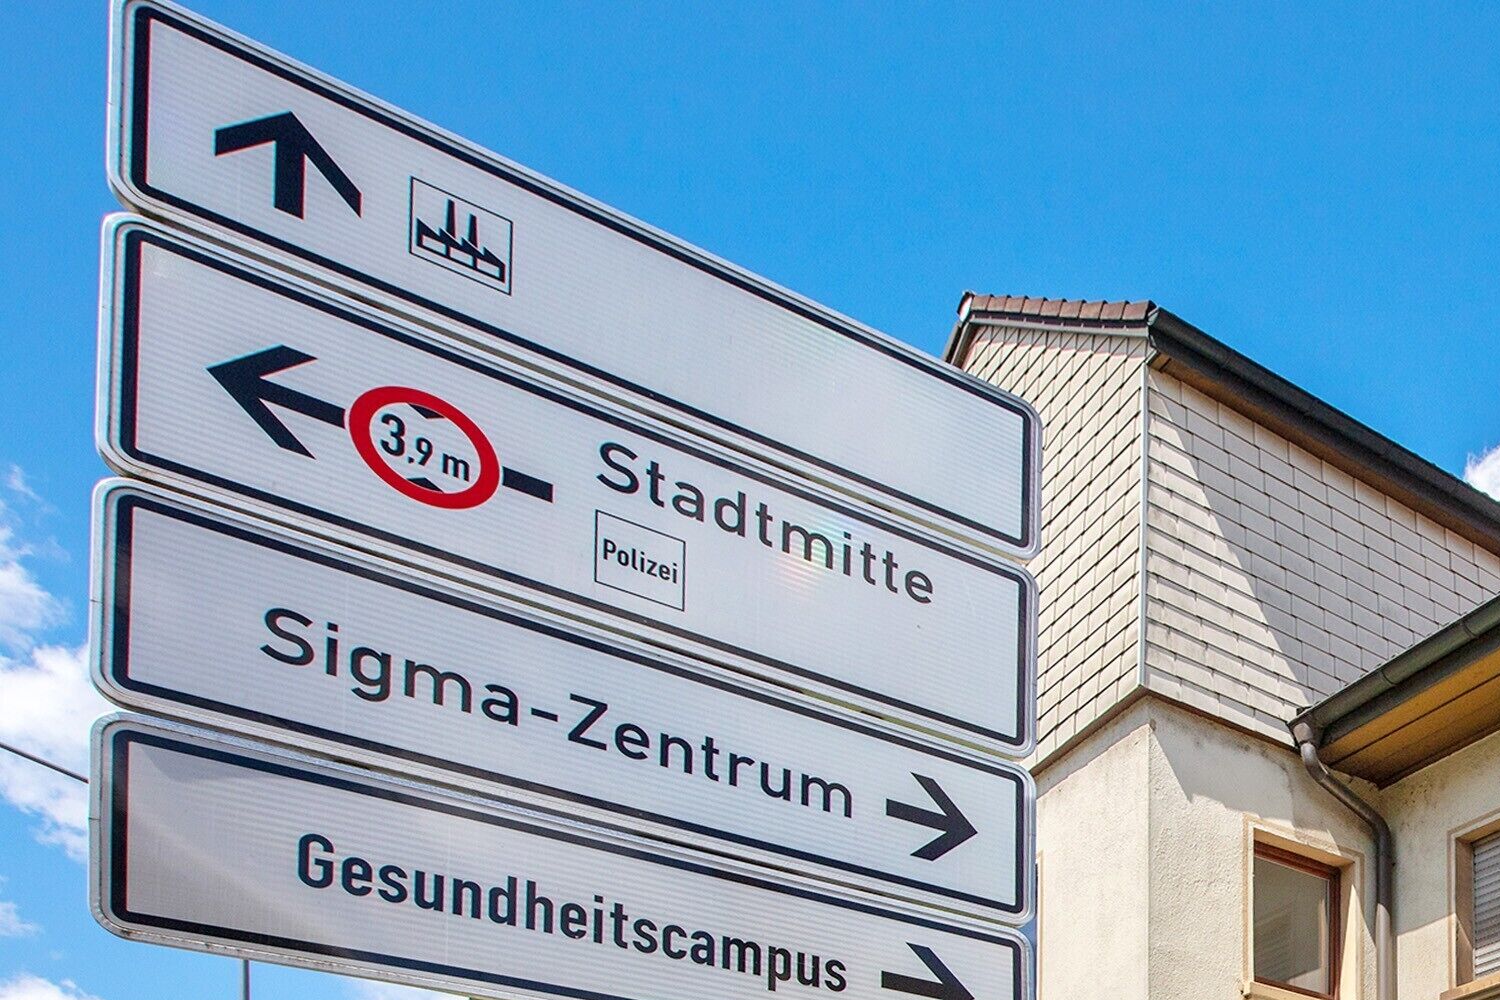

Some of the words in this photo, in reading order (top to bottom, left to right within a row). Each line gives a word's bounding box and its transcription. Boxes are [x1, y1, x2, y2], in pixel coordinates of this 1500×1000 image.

[442, 452, 470, 483] m
[596, 441, 934, 604] Stadtmitte
[603, 538, 678, 584] Polizei
[259, 607, 854, 819] Sigma-Zentrum
[296, 832, 848, 992] Gesundheitscampus
